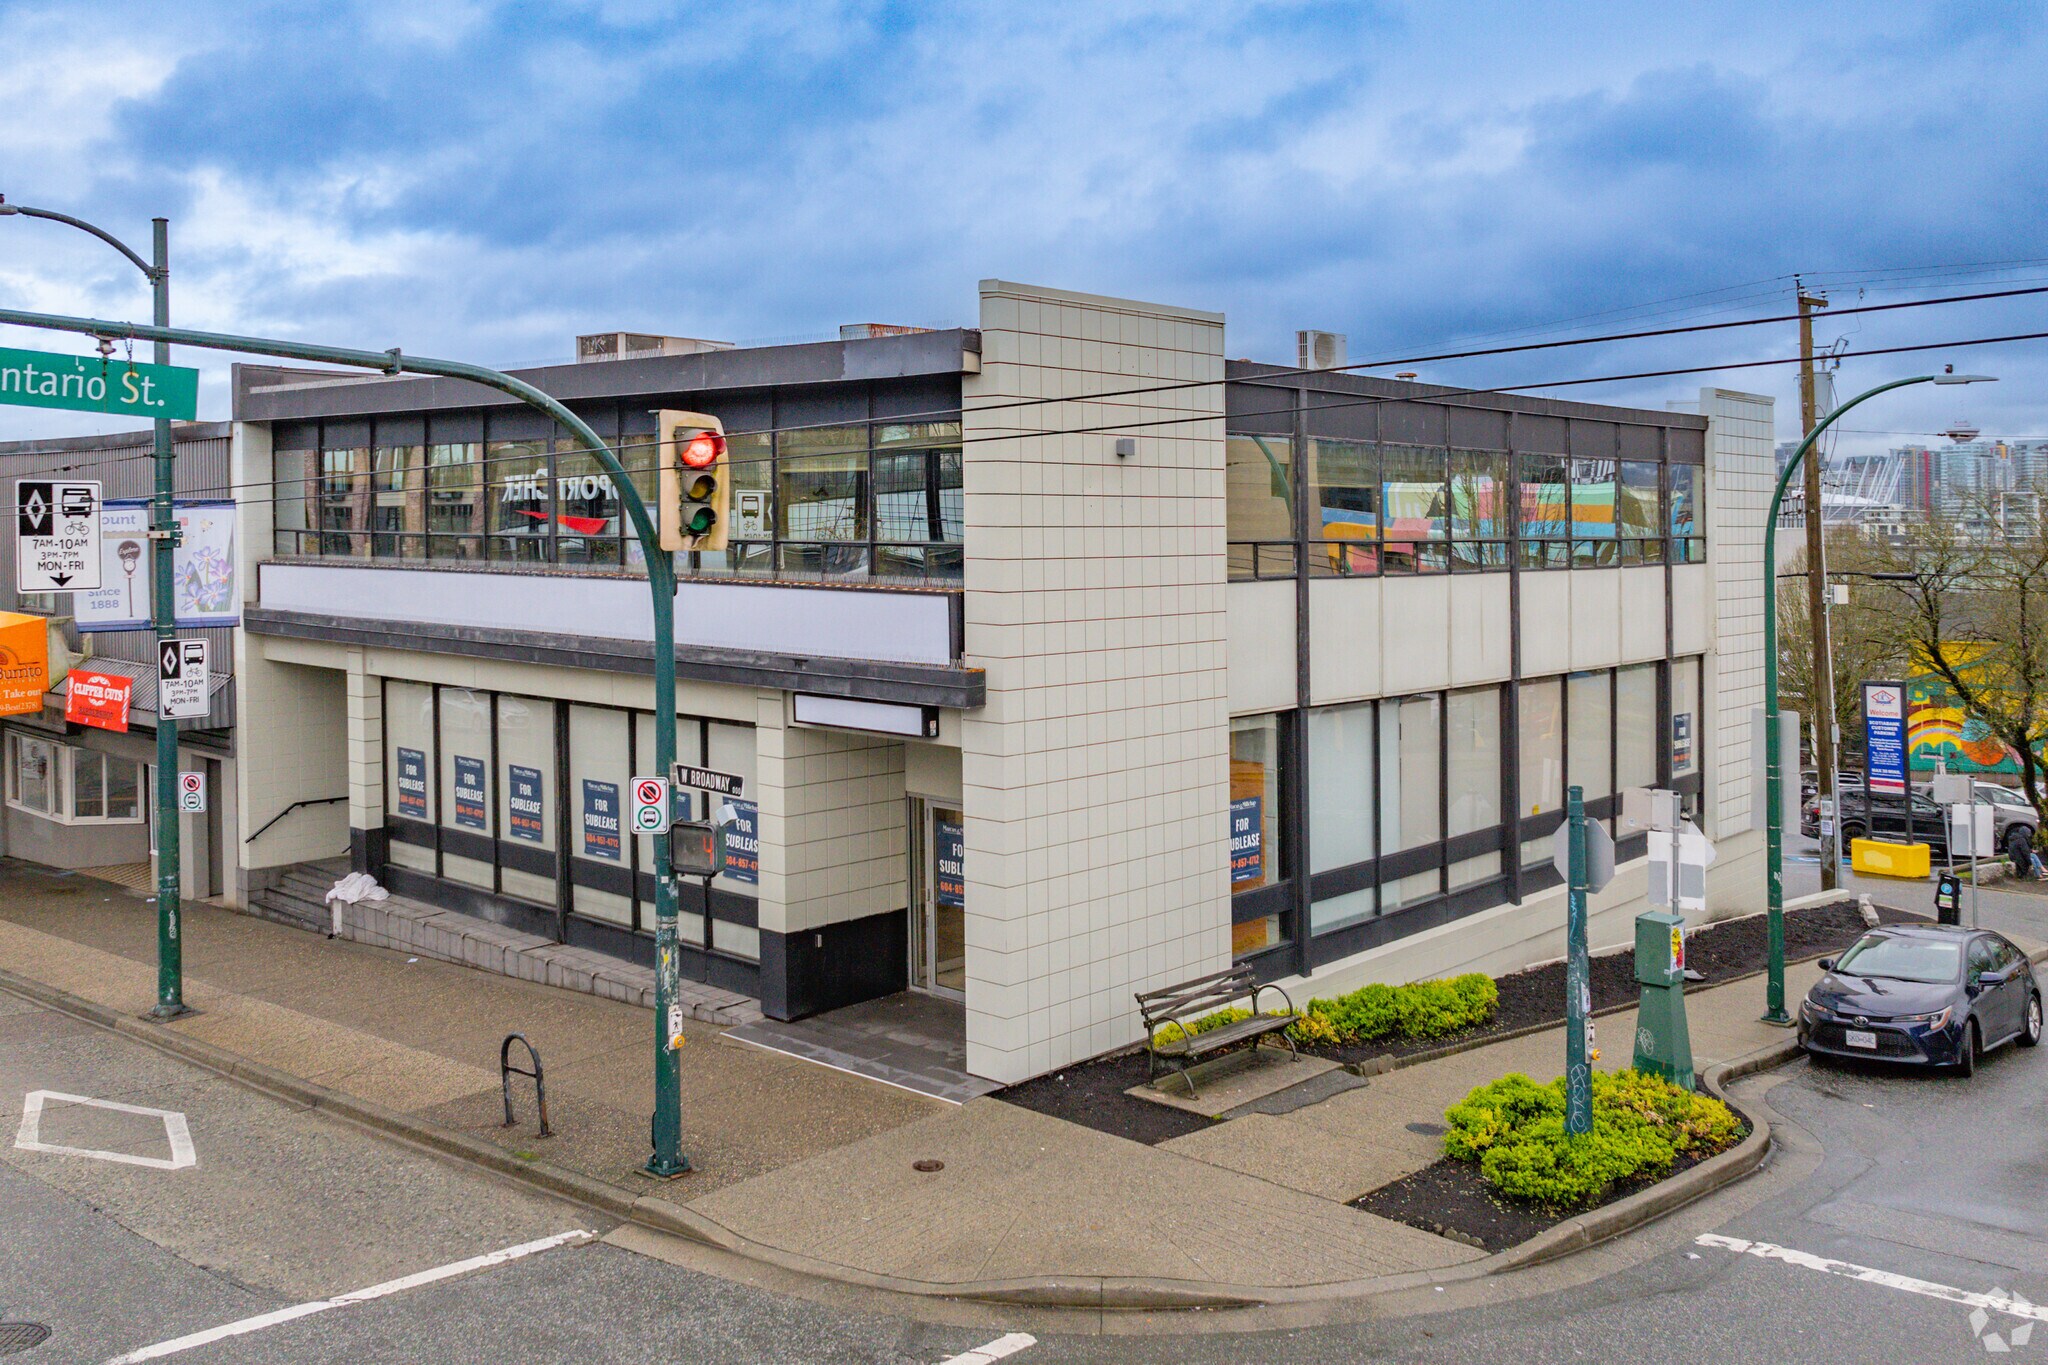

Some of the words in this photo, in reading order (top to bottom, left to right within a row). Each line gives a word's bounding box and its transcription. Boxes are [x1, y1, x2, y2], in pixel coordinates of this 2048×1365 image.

[0, 363, 106, 401] ntario
[120, 371, 165, 407] St.
[102, 514, 136, 526] ount
[32, 538, 88, 550] 7AM-10AM
[41, 551, 79, 560] 3PM-7PM
[91, 599, 119, 610] 1888
[165, 679, 204, 690] 7AM-10AM
[2, 688, 25, 699] Take
[27, 688, 42, 698] out
[74, 682, 104, 700] CLIPPER
[104, 687, 124, 702] CUTS
[171, 689, 198, 697] 3PM-7PM
[1870, 709, 1898, 717] Welcome
[405, 763, 418, 776] FOR
[398, 776, 425, 793] SUBLEASE
[463, 772, 476, 786] FOR
[681, 768, 689, 784] W
[690, 770, 731, 792] BROADWAY
[455, 786, 484, 803] SUBLEASE
[519, 783, 533, 797] FOR
[510, 796, 541, 814] SUBLEASE
[594, 798, 609, 813] FOR
[584, 813, 618, 831] SUBLEASE
[736, 818, 752, 834] FOR
[1236, 818, 1249, 832] FOR
[725, 833, 758, 854] SUBLEAS
[1230, 833, 1260, 851] UBLEASE
[953, 843, 964, 857] FO
